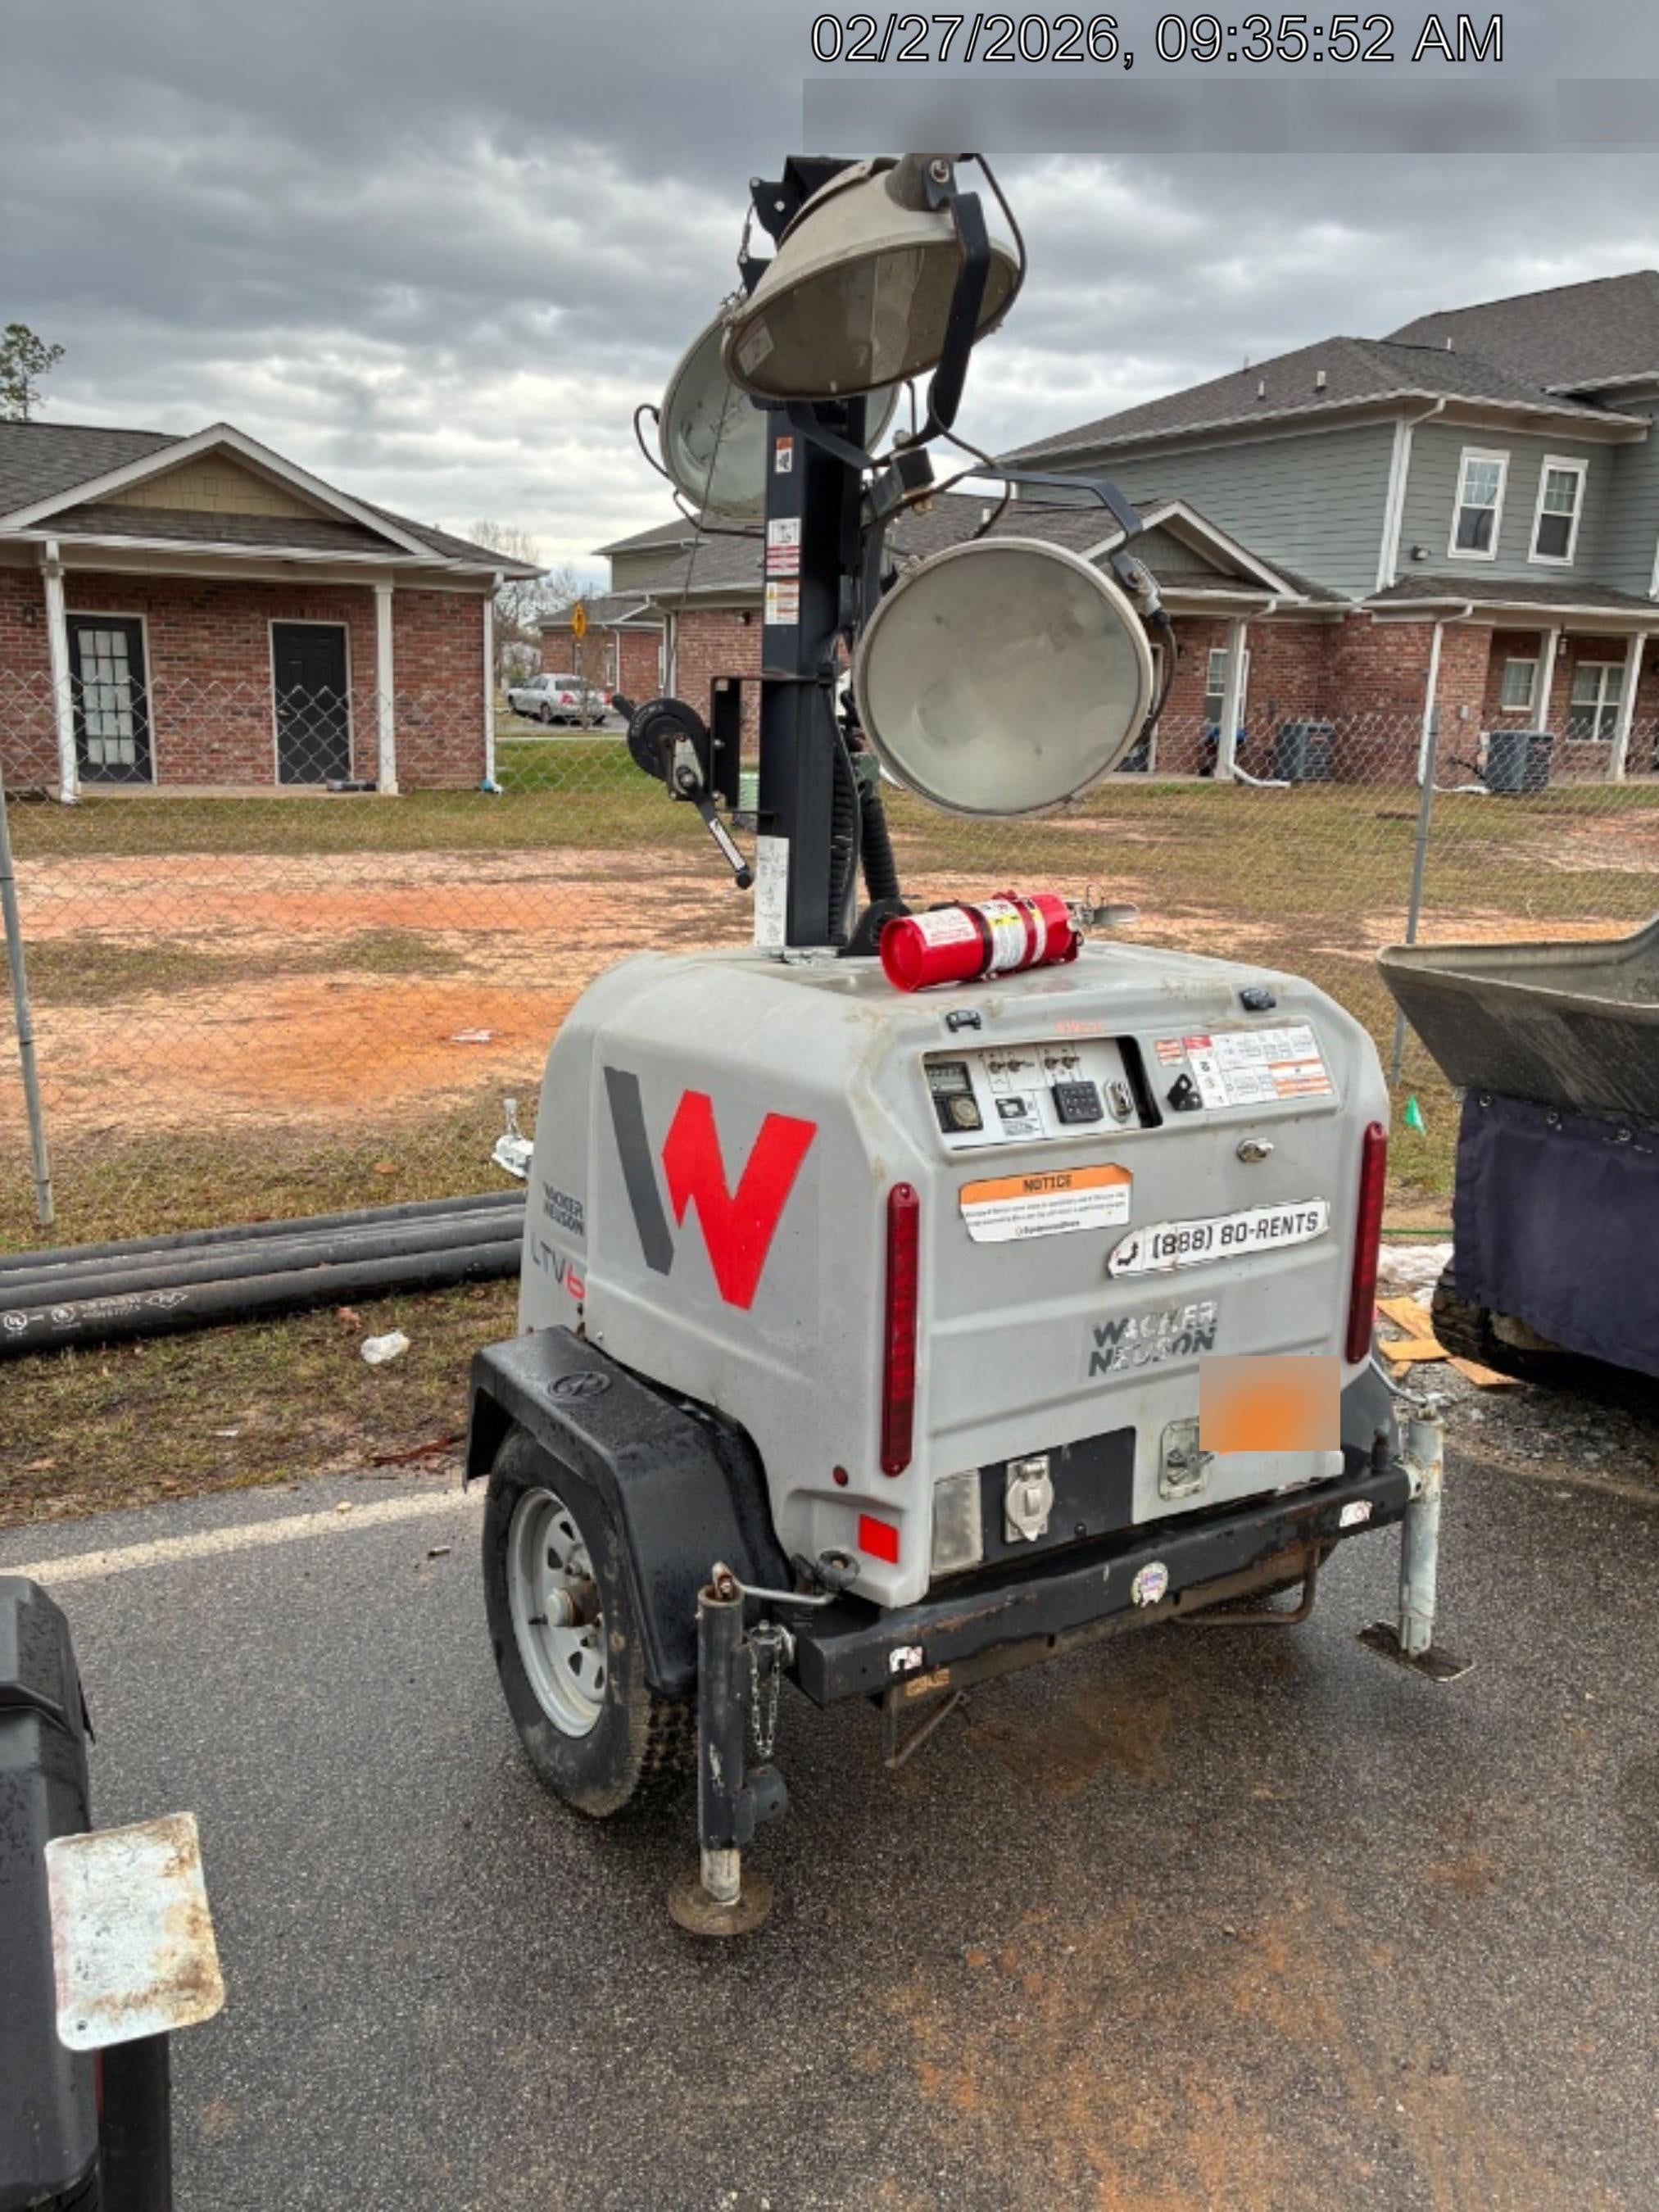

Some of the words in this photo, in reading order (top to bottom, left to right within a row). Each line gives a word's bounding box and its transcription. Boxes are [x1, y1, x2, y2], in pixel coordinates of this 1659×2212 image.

[1023, 1174, 1072, 1193] NOTICE
[1152, 1226, 1213, 1258] (888)
[1221, 1211, 1318, 1245] 80-RENTS
[531, 1231, 586, 1299] LTV6
